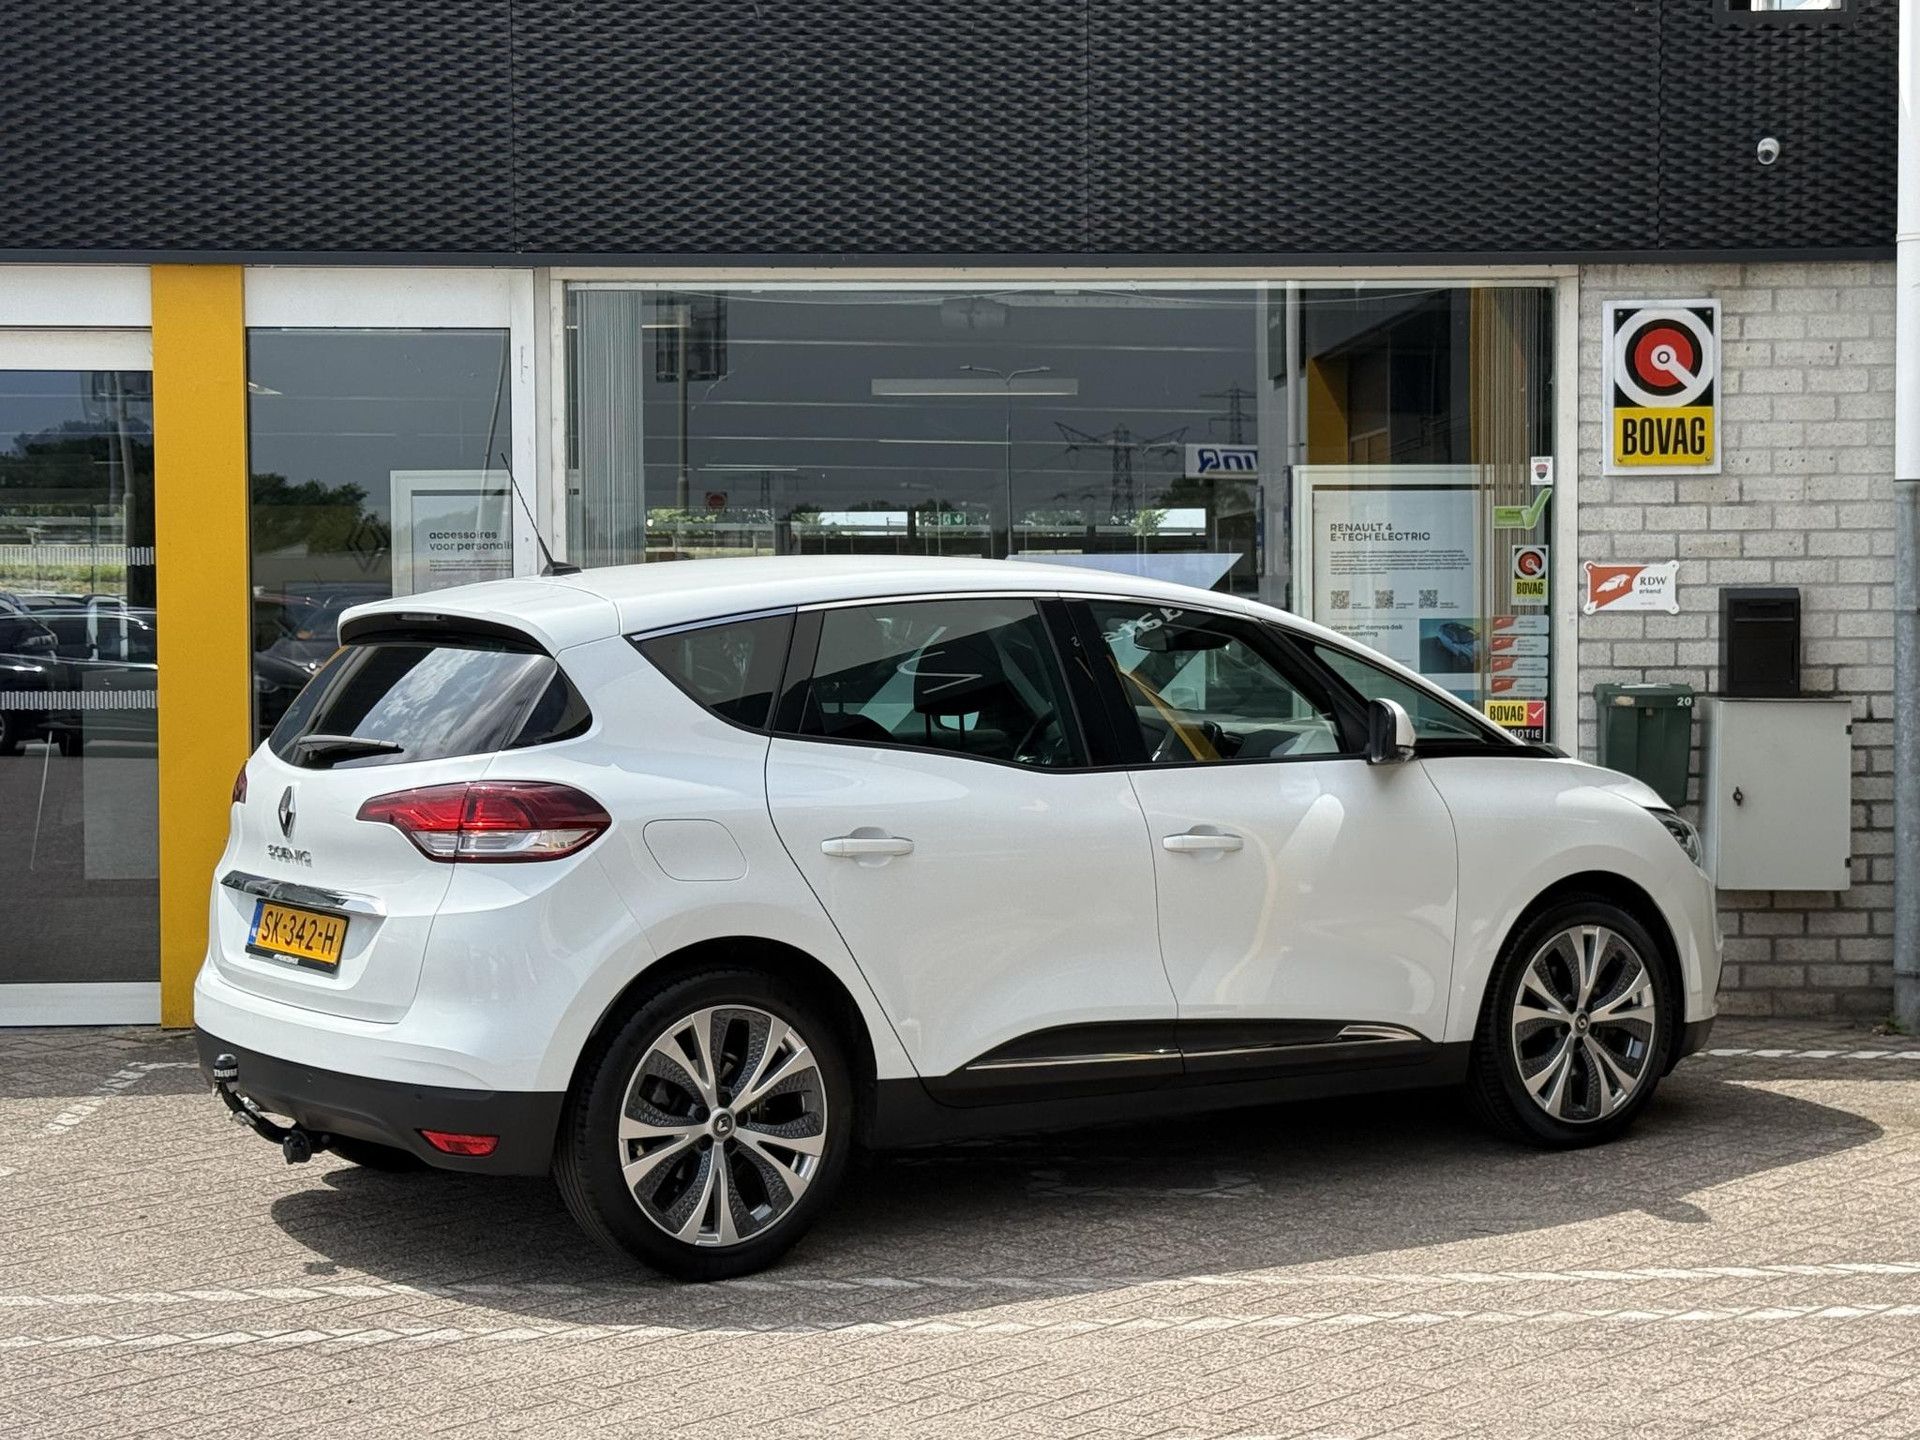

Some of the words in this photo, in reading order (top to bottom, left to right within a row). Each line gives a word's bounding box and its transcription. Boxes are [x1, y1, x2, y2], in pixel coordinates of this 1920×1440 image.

[1622, 416, 1706, 456] BOVAG
[1330, 523, 1383, 532] RENAULT
[1385, 523, 1393, 532] 4
[429, 531, 498, 540] accessoires
[1330, 532, 1372, 541] E-TECH
[1374, 532, 1431, 541] ELECTRIC
[429, 543, 455, 551] voor
[1639, 576, 1667, 586] RDW
[1516, 582, 1544, 595] BOVAG
[1677, 697, 1692, 706] 20
[1489, 705, 1524, 721] BOVAG
[261, 910, 338, 956] SK-342-H
